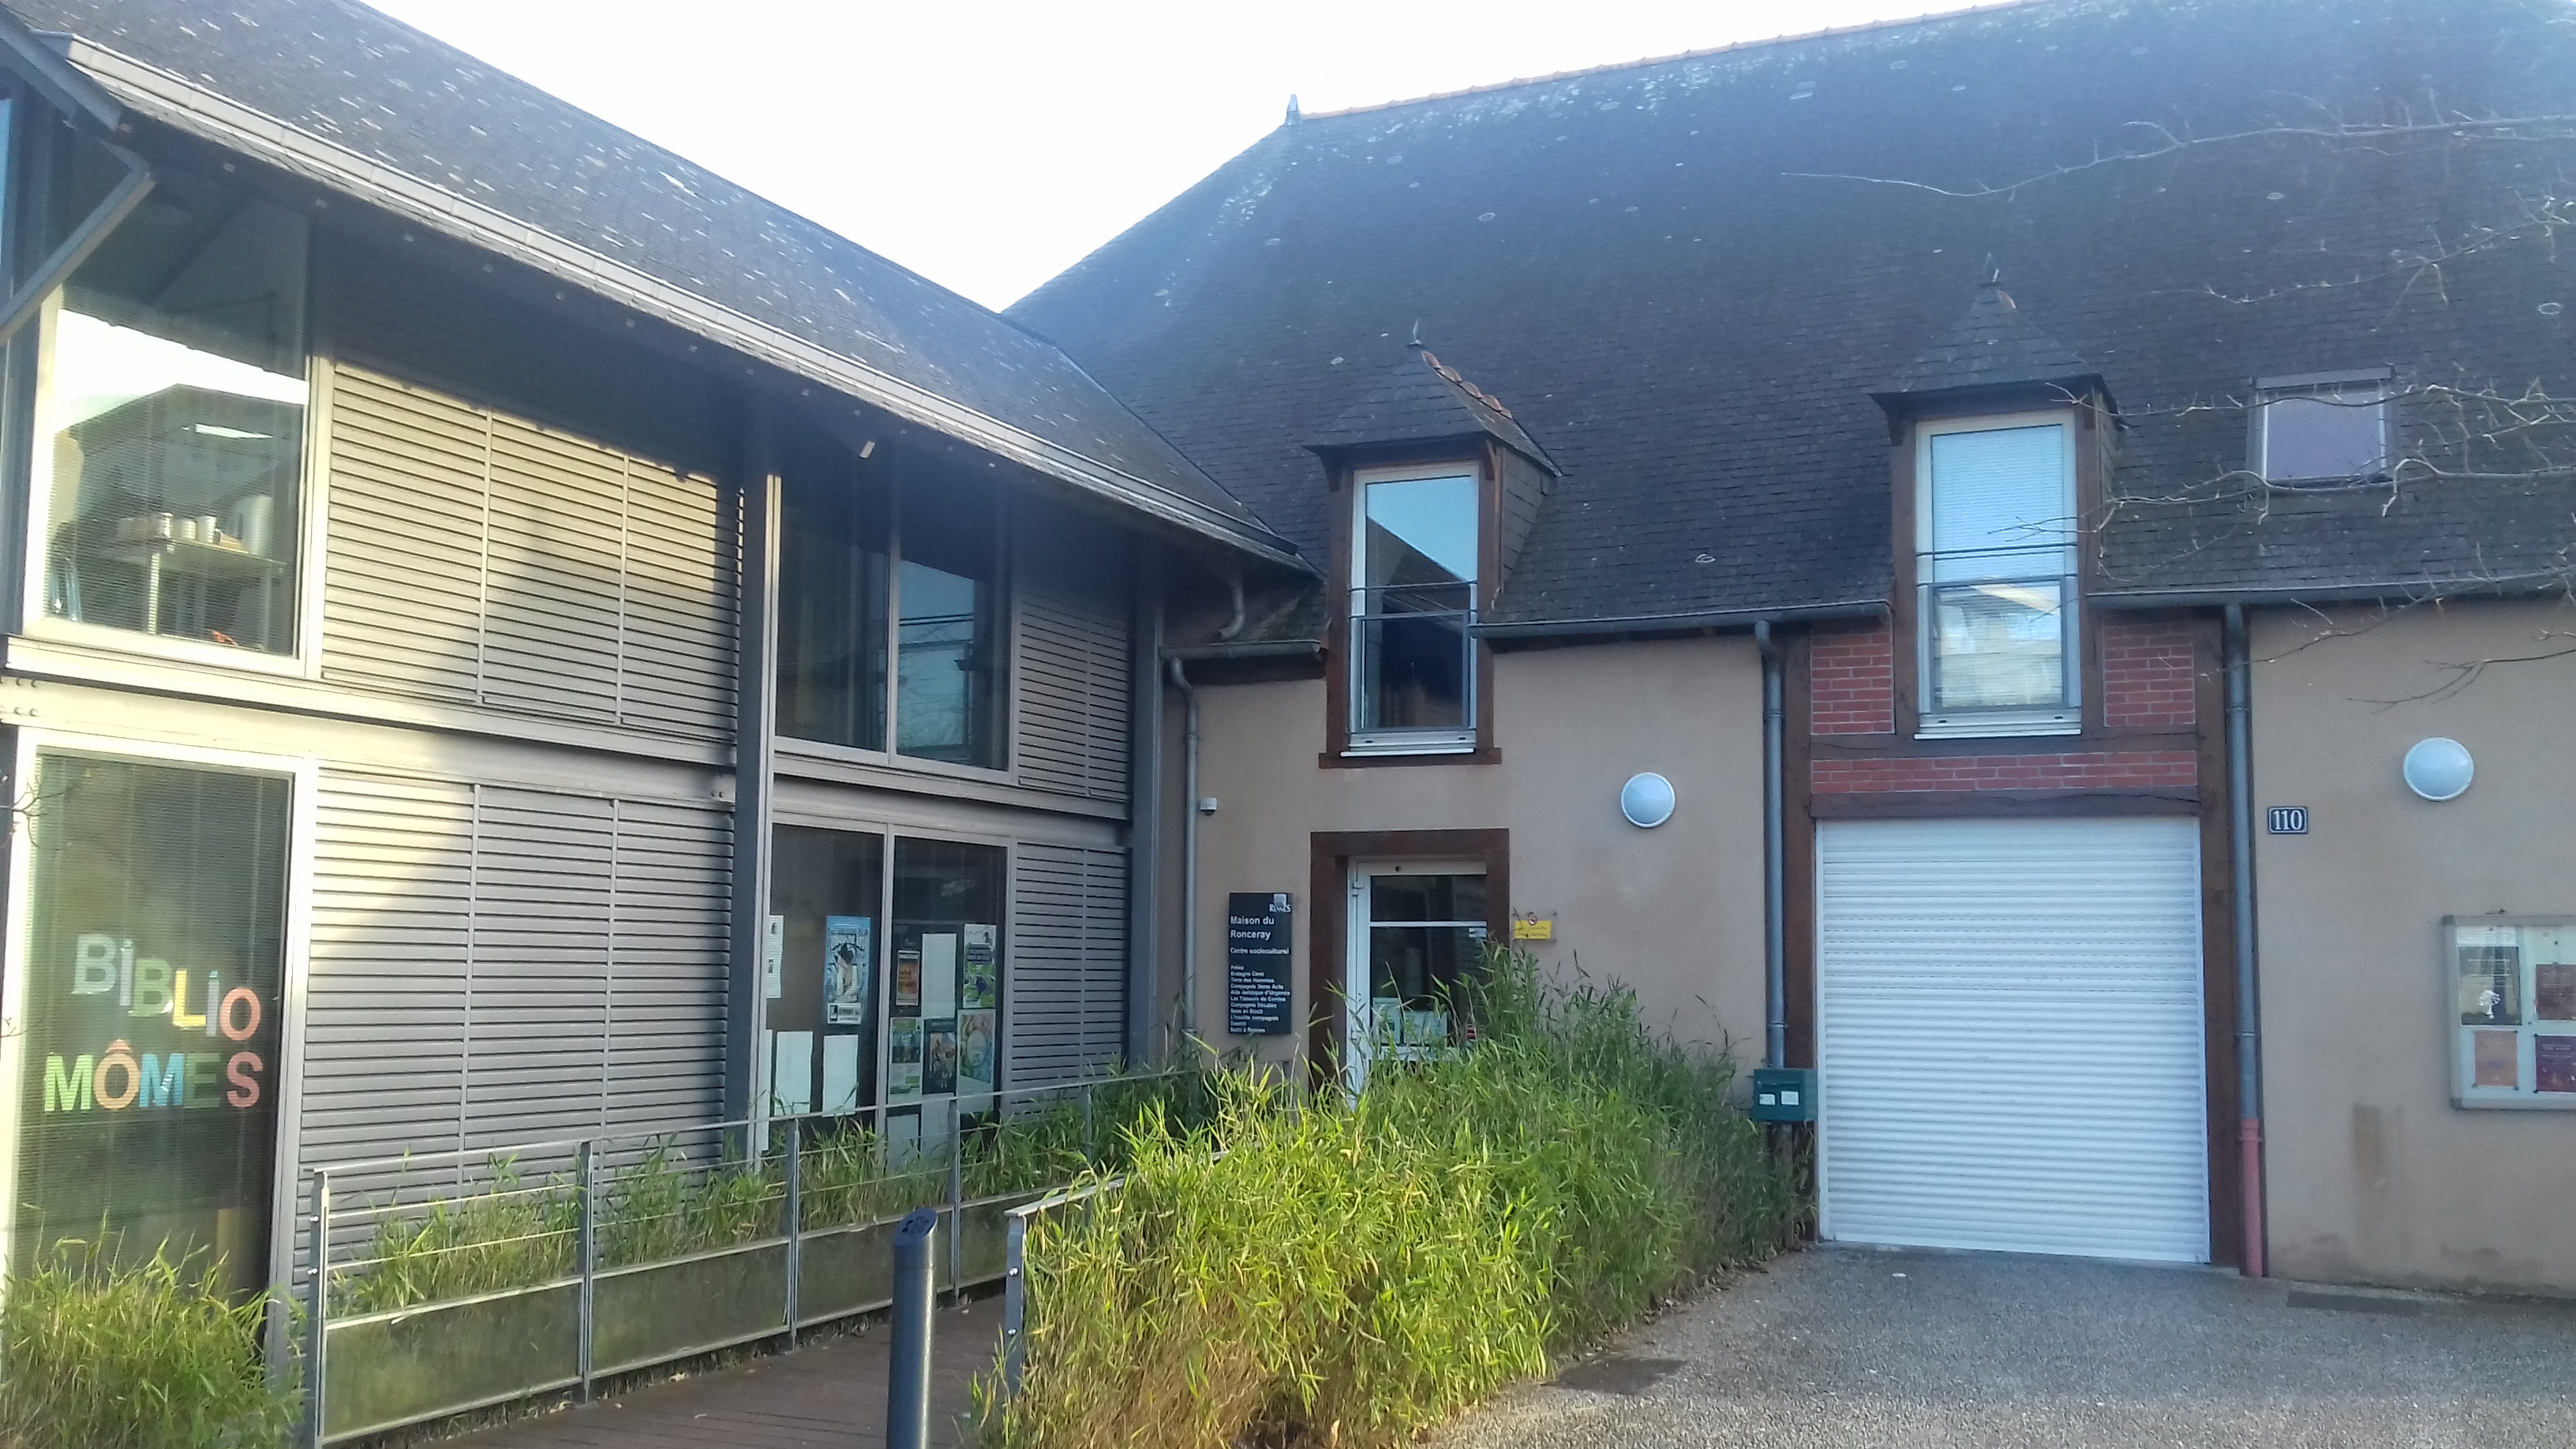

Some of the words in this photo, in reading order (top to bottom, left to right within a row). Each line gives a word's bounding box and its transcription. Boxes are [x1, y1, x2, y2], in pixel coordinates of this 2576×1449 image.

[2273, 810, 2302, 829] 110
[1230, 915, 1260, 925] Maison
[1263, 916, 1275, 925] du
[1230, 930, 1271, 941] Ronceray
[44, 1039, 263, 1111] MÔMES
